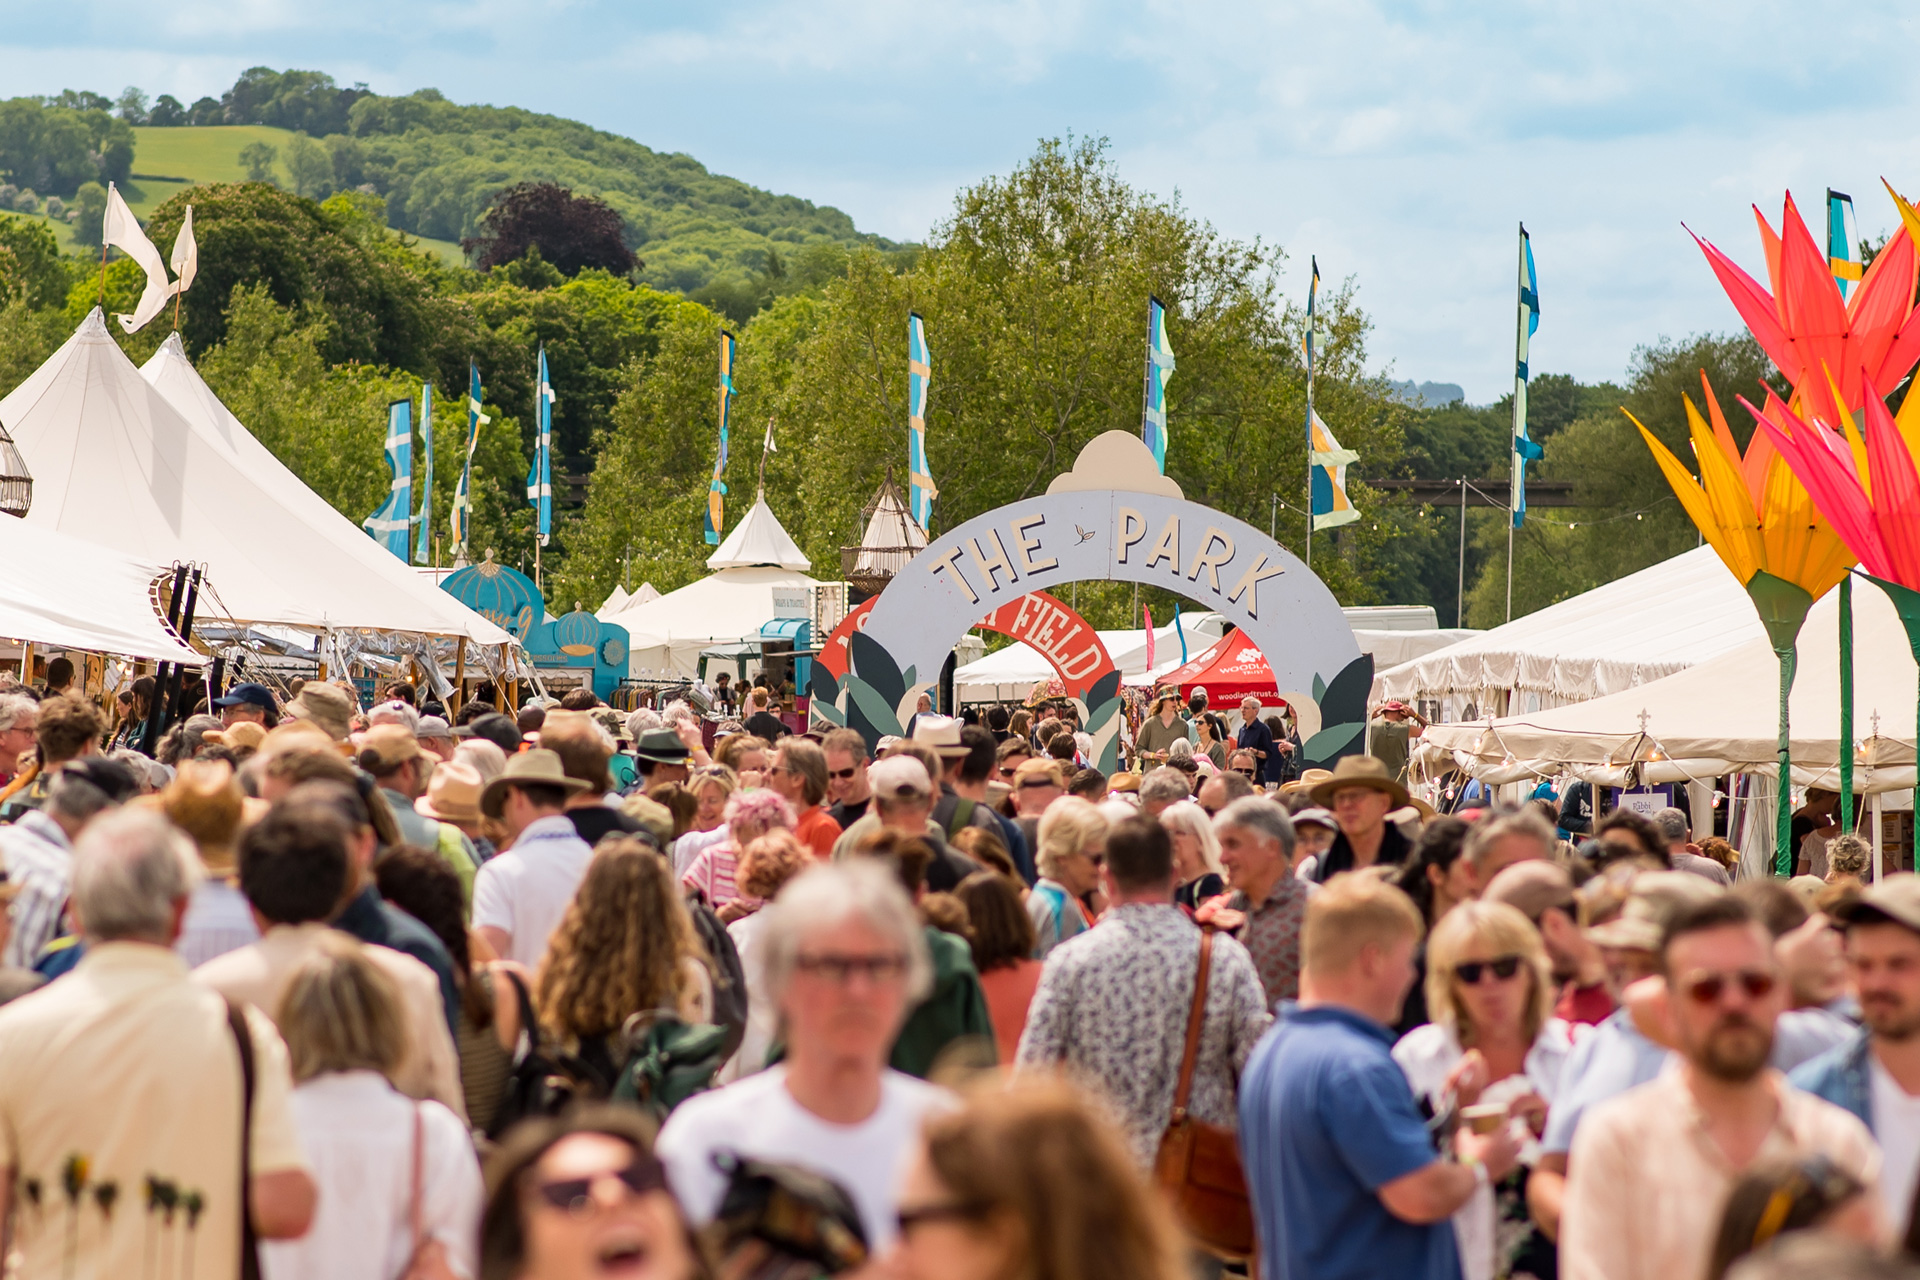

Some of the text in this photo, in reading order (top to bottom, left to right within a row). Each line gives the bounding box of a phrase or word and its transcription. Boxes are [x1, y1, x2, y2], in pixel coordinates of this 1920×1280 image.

[927, 506, 1285, 621] THE PARK
[1011, 593, 1102, 680] FIELD
[1219, 663, 1272, 674] WOODLA
